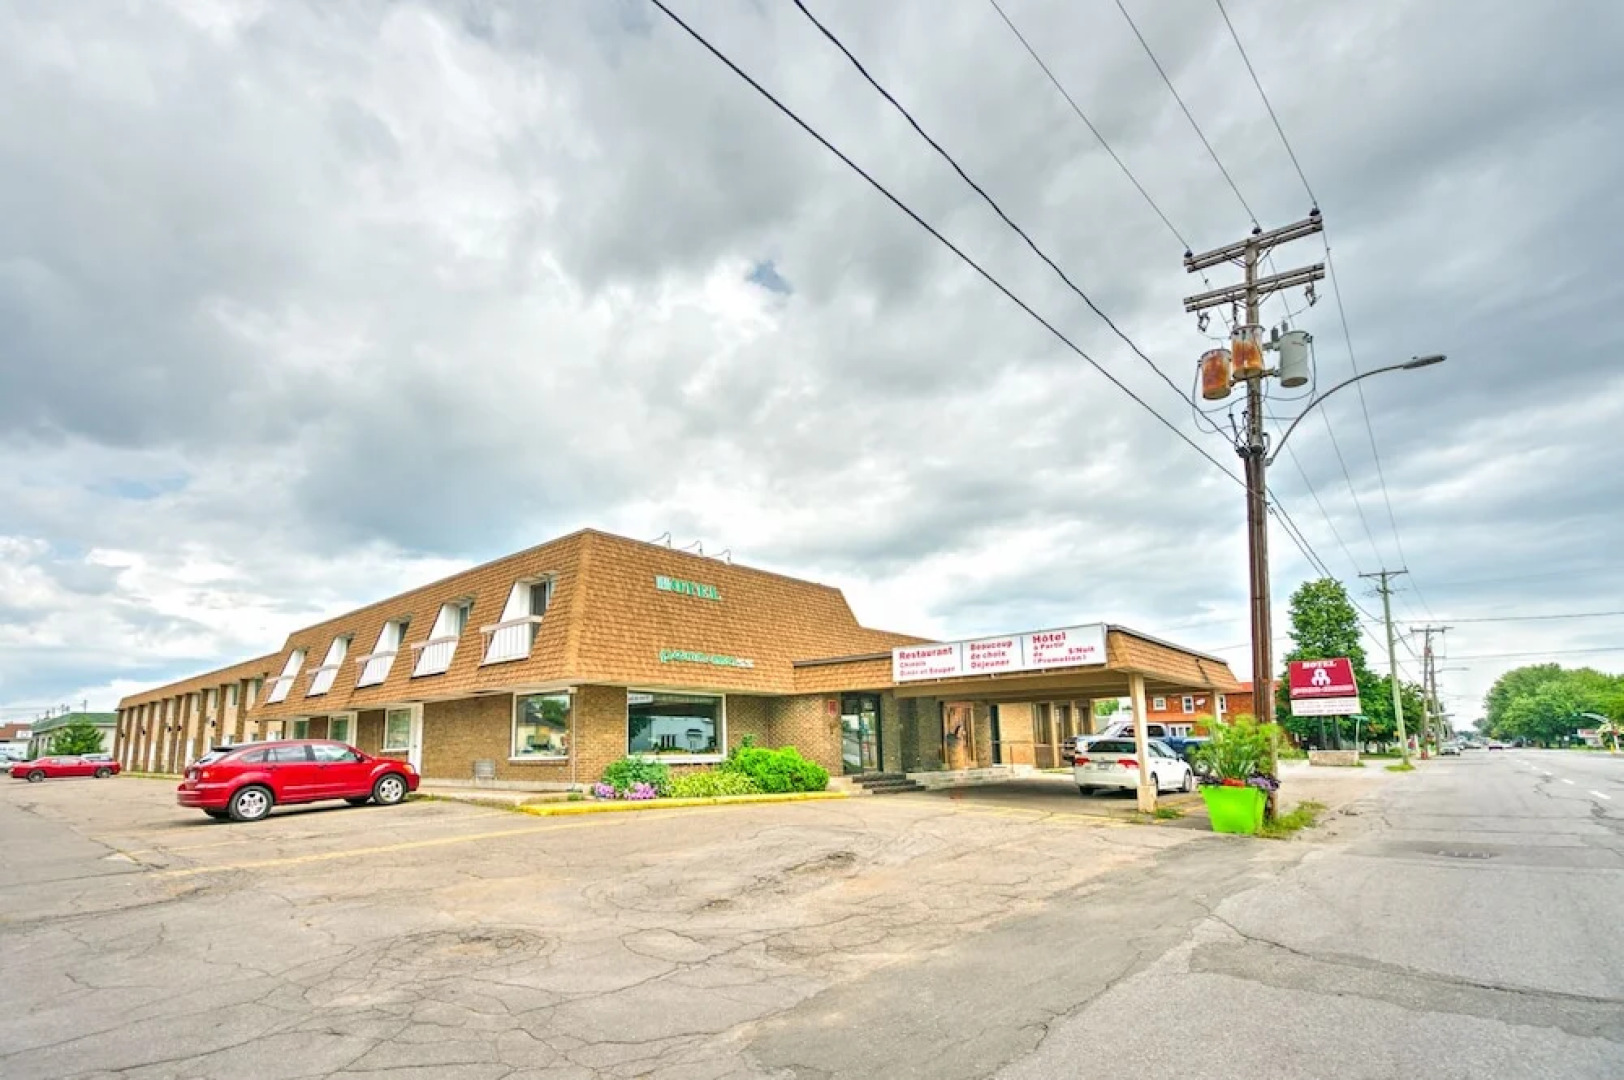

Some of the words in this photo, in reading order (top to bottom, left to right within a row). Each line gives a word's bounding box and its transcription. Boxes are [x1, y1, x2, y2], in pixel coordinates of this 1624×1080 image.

[970, 641, 1012, 651] Beaucoup
[899, 647, 952, 659] Restaurant
[970, 652, 980, 660] de
[982, 650, 1007, 659] choix
[929, 666, 955, 675] Souper
